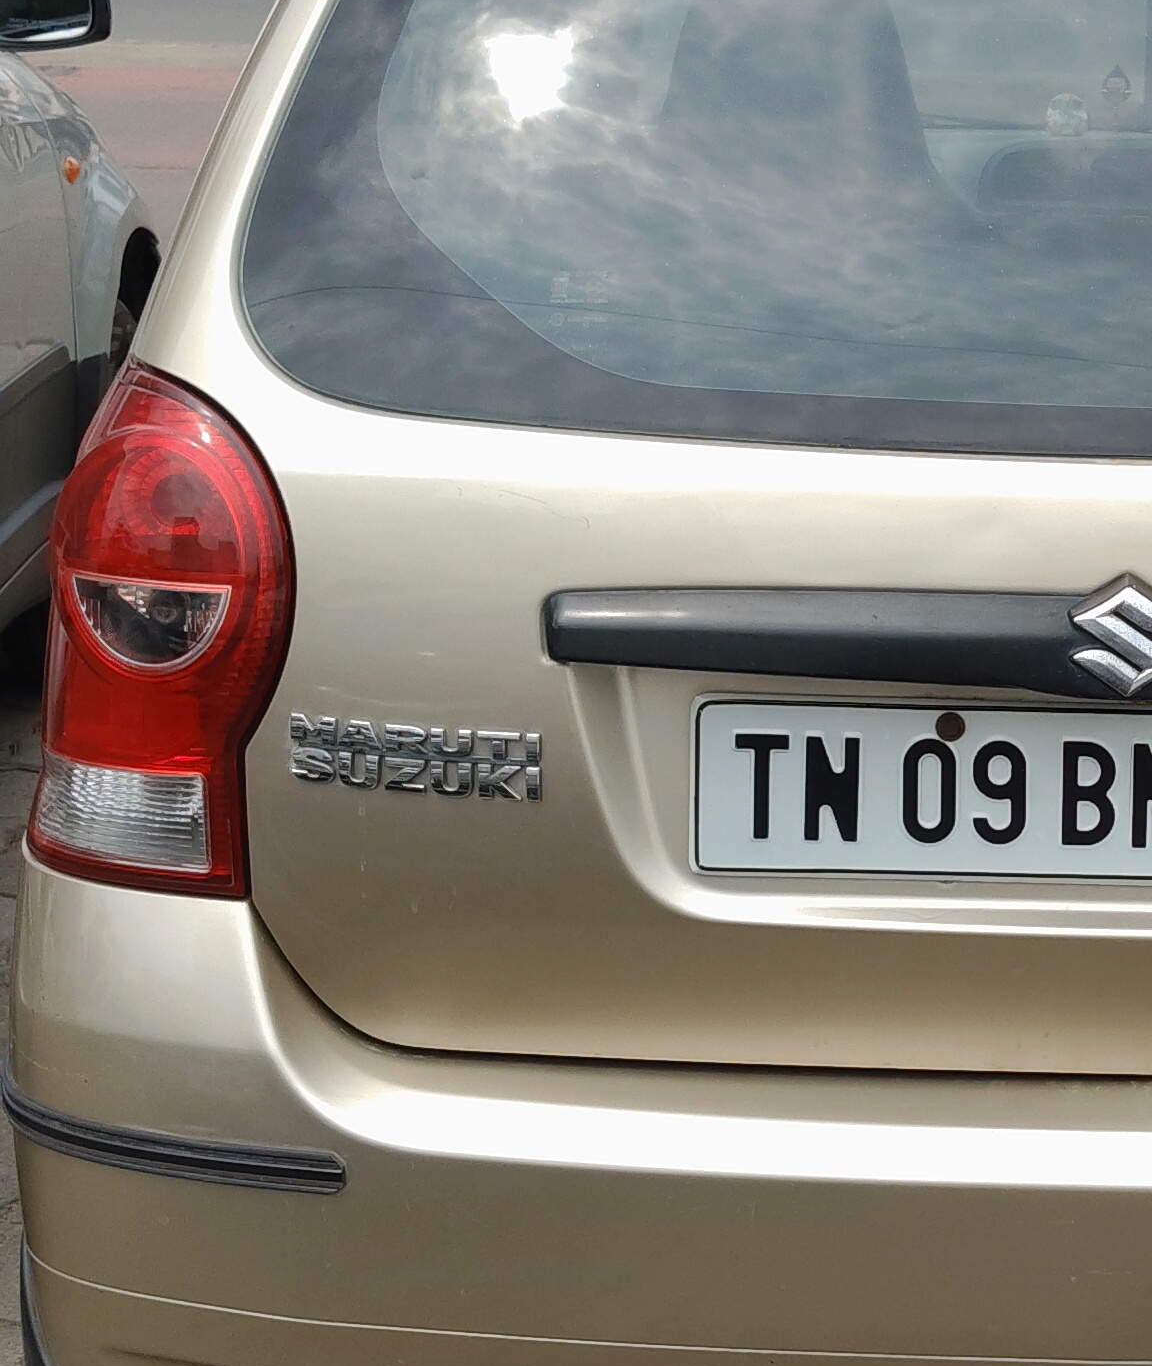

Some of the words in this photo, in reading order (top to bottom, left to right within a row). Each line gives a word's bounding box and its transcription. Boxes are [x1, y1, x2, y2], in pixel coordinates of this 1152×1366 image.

[290, 712, 542, 762] MARUTI
[290, 747, 542, 803] SUZUKI
[733, 734, 860, 842] TN
[902, 738, 1027, 845] 09
